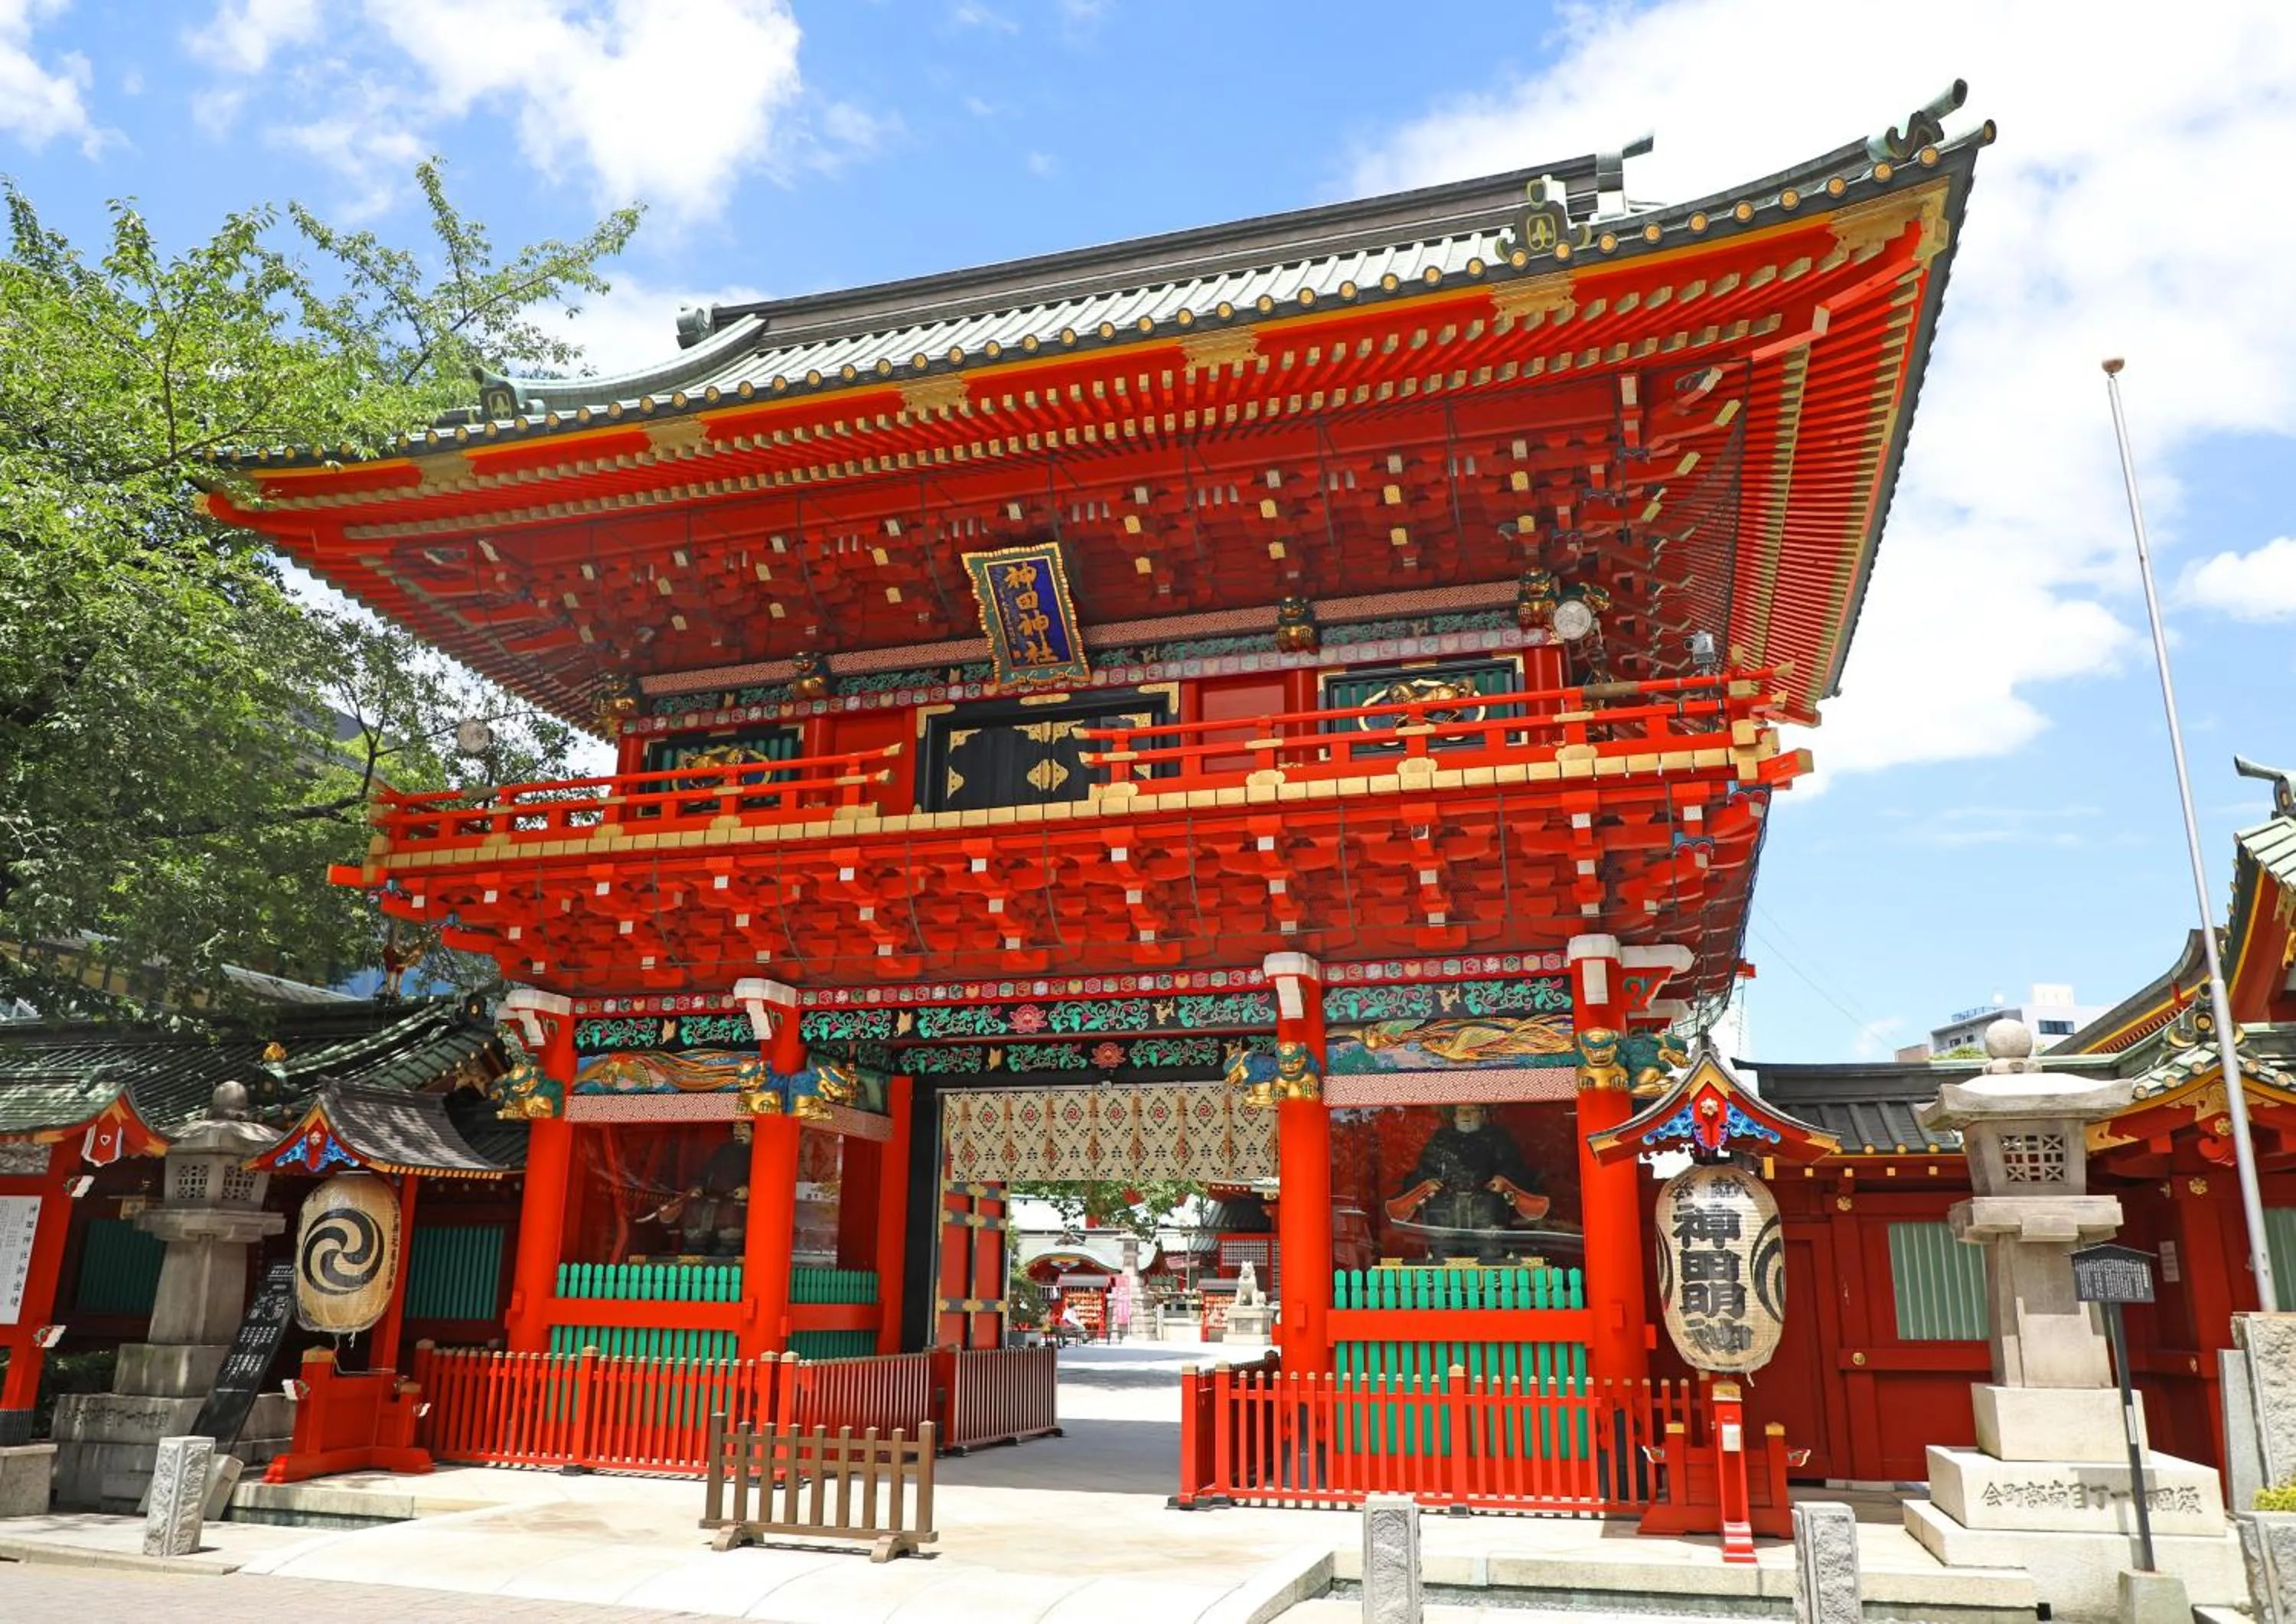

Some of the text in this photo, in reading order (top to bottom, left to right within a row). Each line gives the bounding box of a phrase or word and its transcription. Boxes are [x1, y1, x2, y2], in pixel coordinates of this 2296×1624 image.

[1004, 561, 1059, 664] 神田神社
[1671, 1202, 1754, 1355] 神田明神
